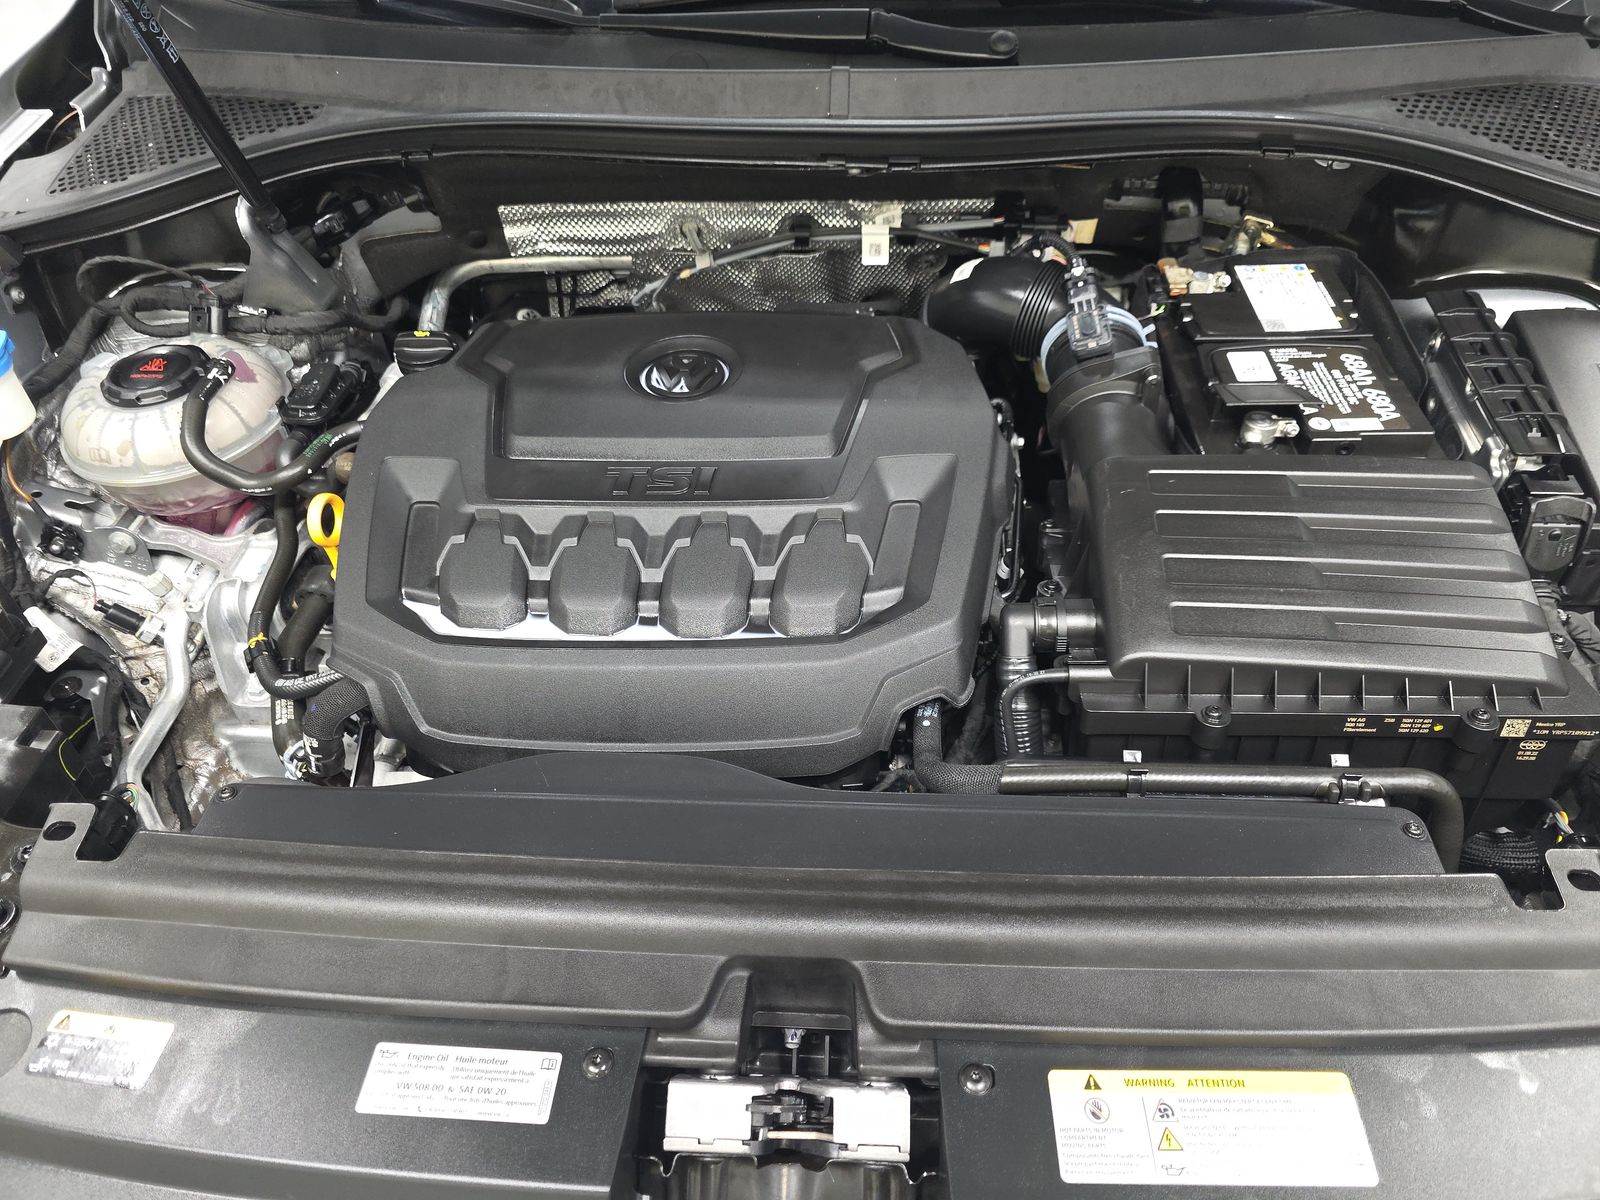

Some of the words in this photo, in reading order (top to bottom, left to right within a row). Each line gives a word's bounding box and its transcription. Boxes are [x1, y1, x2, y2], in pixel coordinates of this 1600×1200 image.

[1340, 352, 1377, 386] 68Ah
[1361, 388, 1401, 422] 680A
[605, 466, 717, 497] TSI
[407, 1052, 435, 1062] Engine
[437, 1054, 449, 1062] Oil
[455, 1055, 477, 1064] Huile
[478, 1056, 509, 1066] moteur
[397, 1082, 413, 1090] VW
[414, 1082, 431, 1091] 508
[432, 1083, 444, 1092] 00
[459, 1085, 475, 1094] SAE
[1123, 1078, 1175, 1088] WARNING
[1187, 1078, 1246, 1088] ATTENTION
